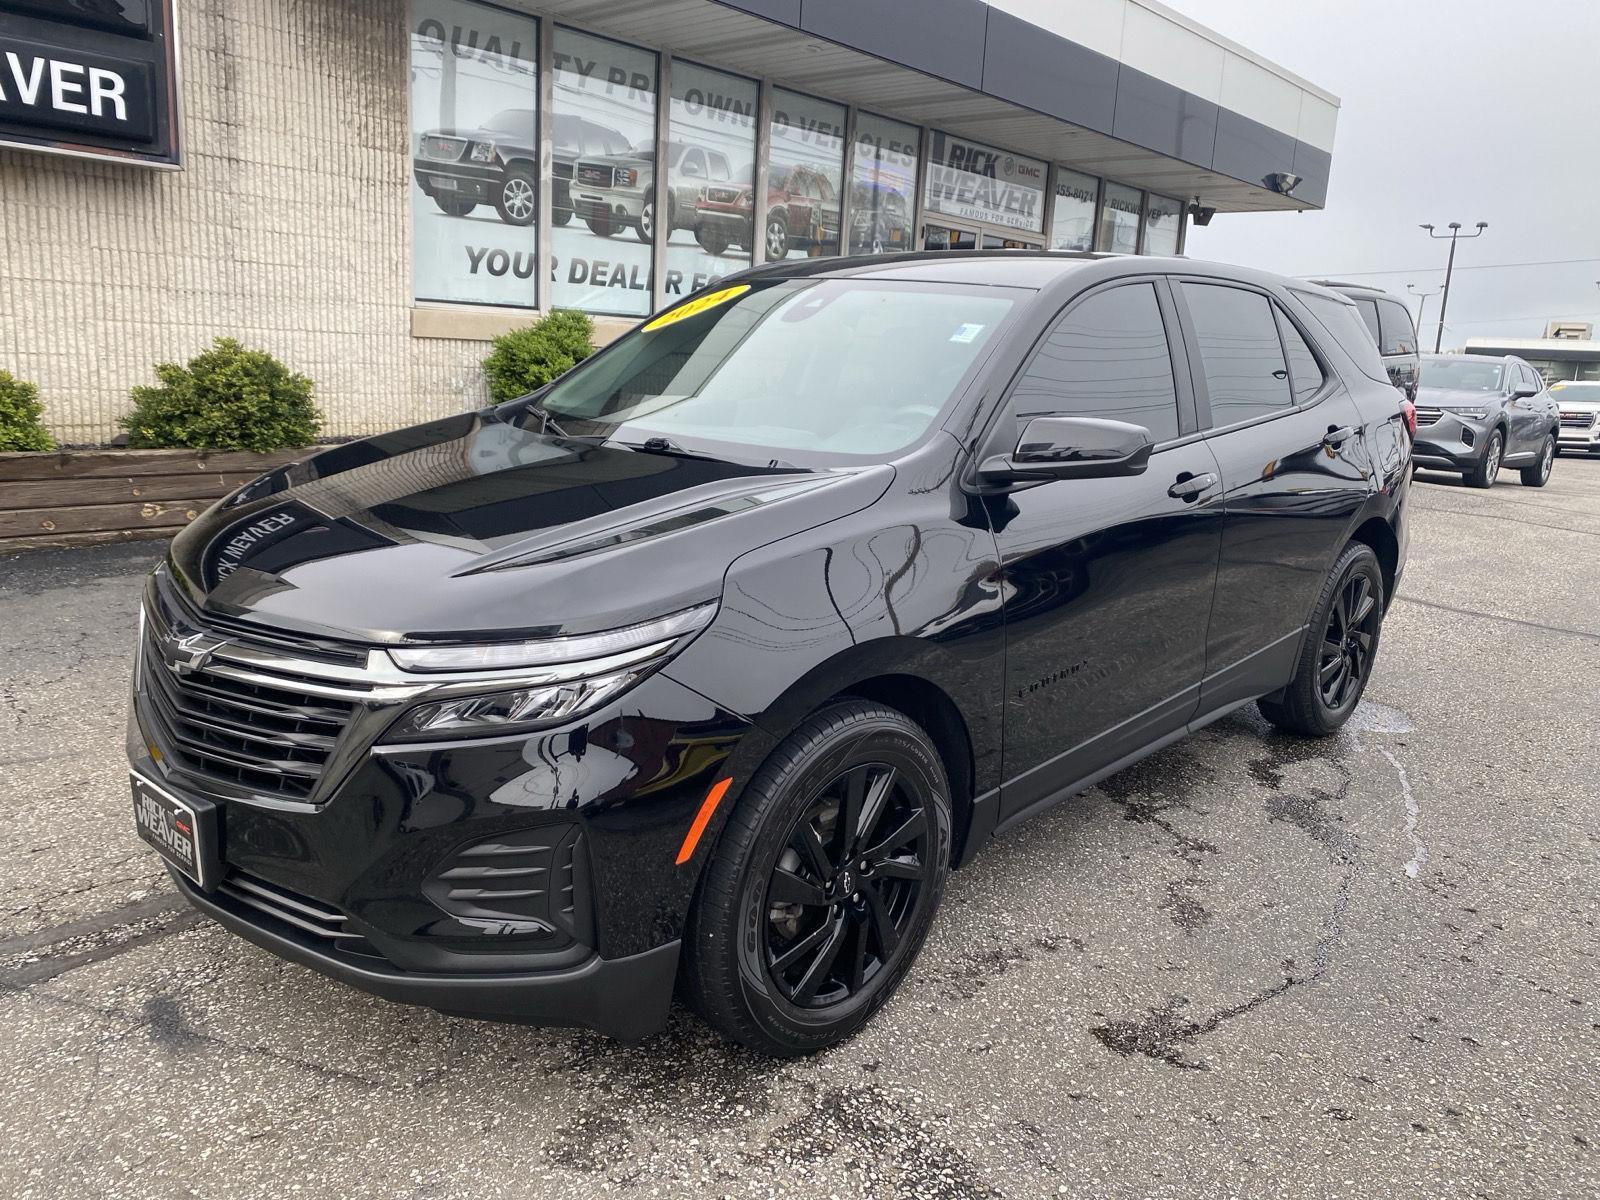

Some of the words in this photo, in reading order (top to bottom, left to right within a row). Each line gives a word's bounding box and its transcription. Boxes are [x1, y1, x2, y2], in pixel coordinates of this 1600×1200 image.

[0, 51, 127, 120] VER
[417, 19, 597, 88] QUALTY
[606, 66, 790, 136] PR-OWND
[800, 116, 914, 167] VECLES
[948, 143, 999, 179] RICK
[1018, 165, 1040, 178] GMC
[933, 168, 1037, 217] WEAVER
[142, 792, 165, 818] RICK
[136, 803, 192, 861] WEAVER
